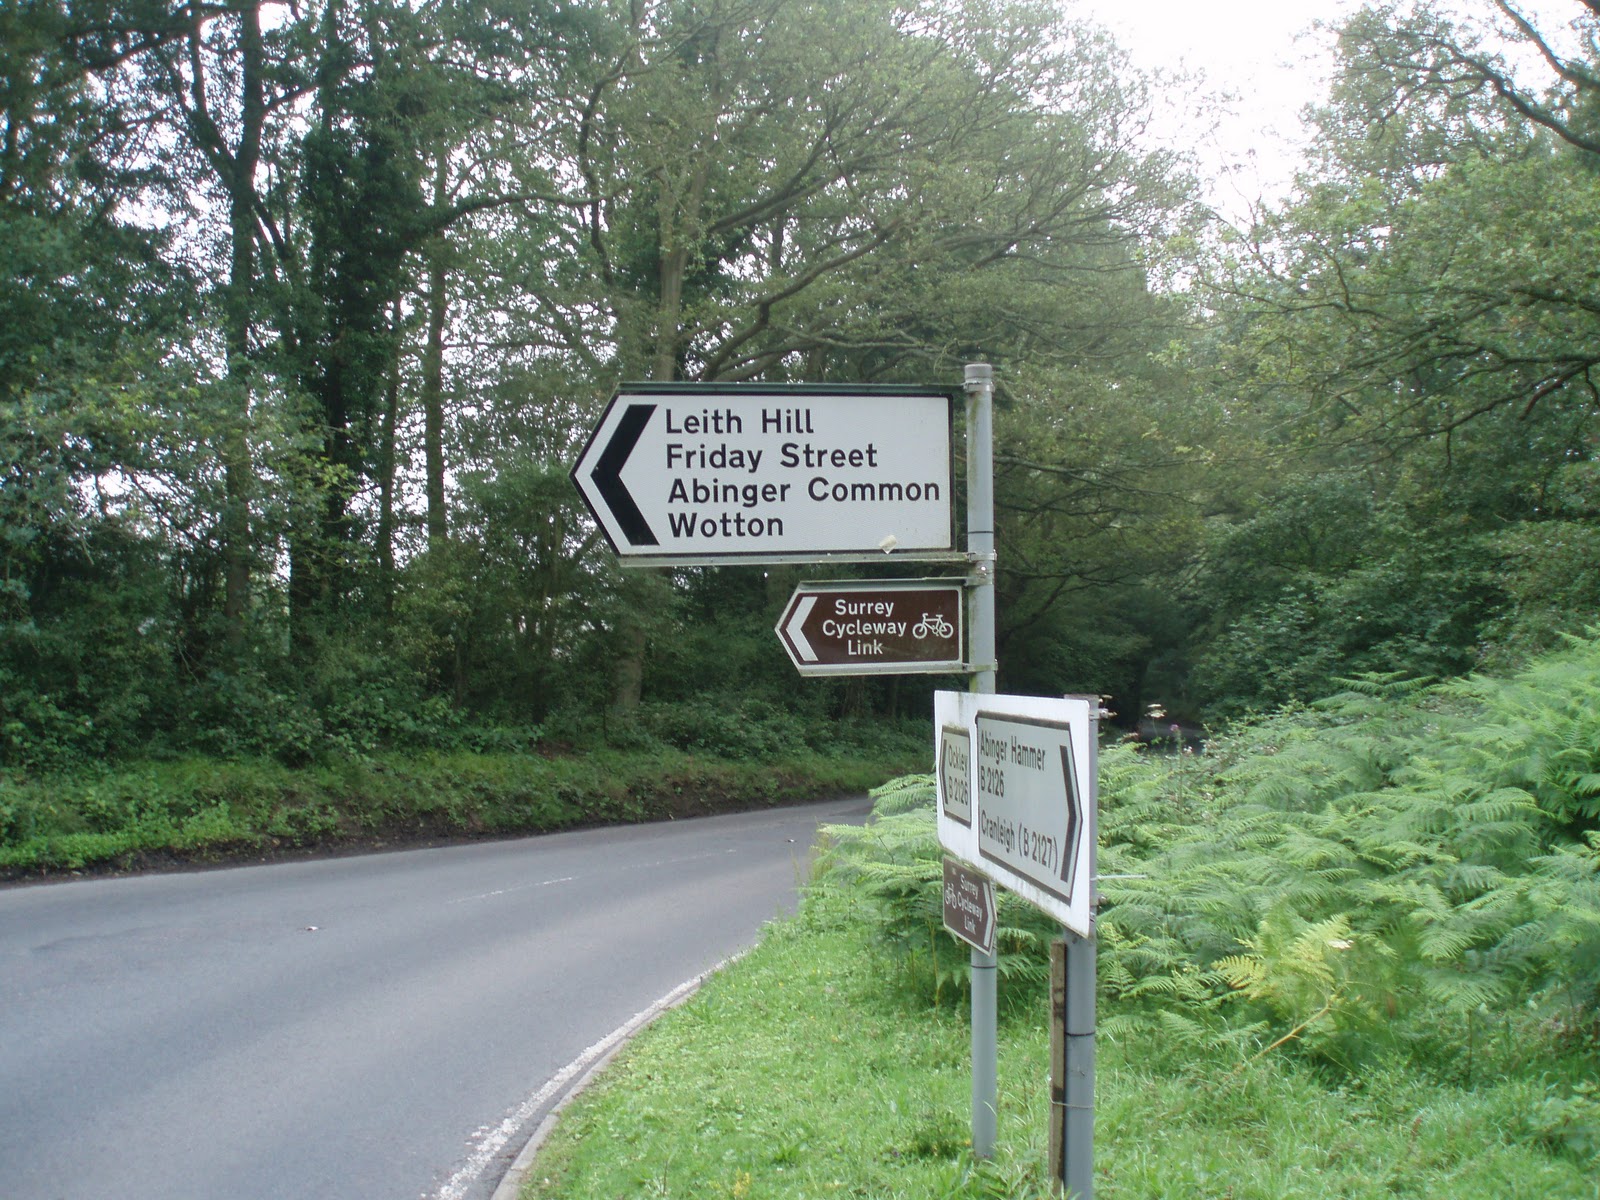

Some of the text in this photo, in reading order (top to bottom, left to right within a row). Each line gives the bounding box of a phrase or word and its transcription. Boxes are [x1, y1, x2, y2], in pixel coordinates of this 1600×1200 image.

[666, 408, 814, 434] Leith Hill
[666, 442, 878, 473] Friday Street
[668, 477, 940, 508] Abinger Common
[668, 512, 784, 538] Wotton
[835, 599, 895, 618] Surrey
[822, 619, 907, 639] Cycleway
[848, 640, 883, 656] Link
[948, 745, 968, 777] Ockley
[980, 730, 1046, 771] Abinger Hammer
[954, 778, 968, 806] 2126
[980, 765, 1005, 798] B 2126
[981, 809, 1058, 875] Cranleigh (B 2127)
[961, 874, 979, 900] Surrey
[958, 891, 982, 922] Cycleway
[964, 914, 976, 935] Link
